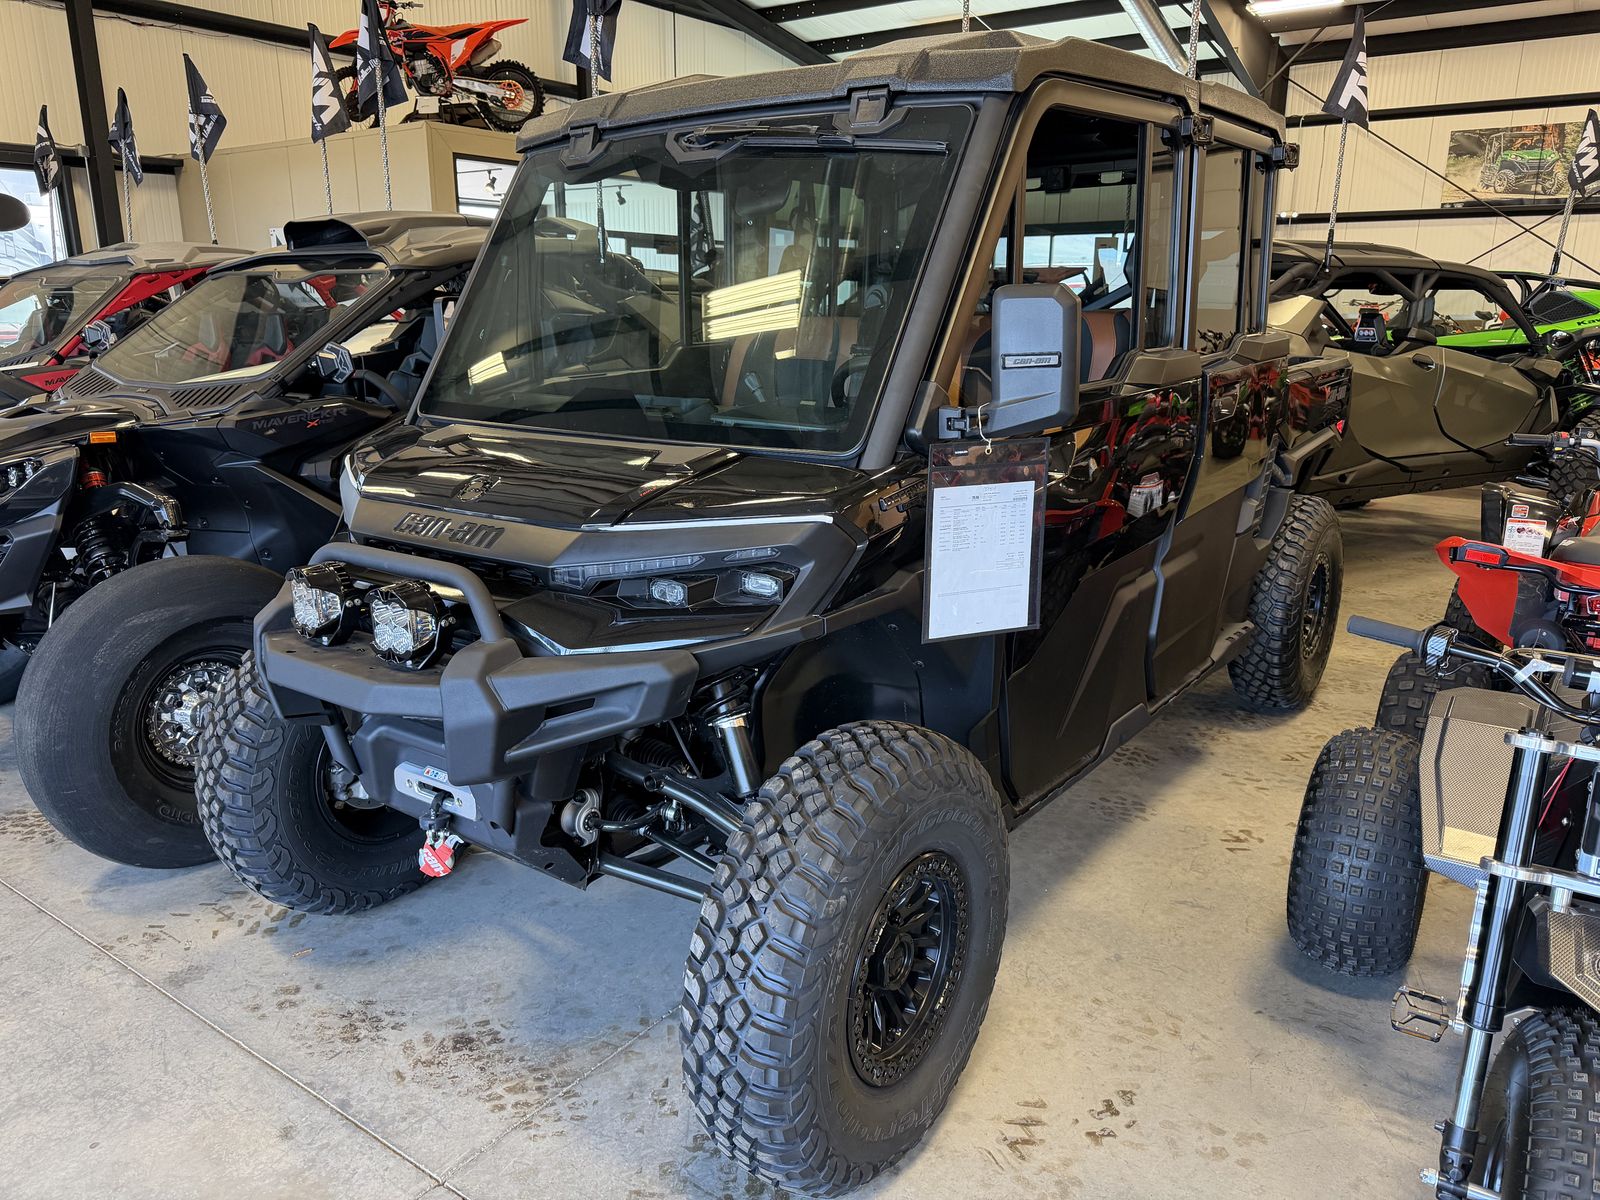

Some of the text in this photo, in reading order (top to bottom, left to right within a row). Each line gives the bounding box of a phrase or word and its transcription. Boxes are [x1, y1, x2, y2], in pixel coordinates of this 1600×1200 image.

[1012, 356, 1052, 365] can-am
[250, 408, 333, 430] MAVERICK
[393, 512, 506, 549] can-am
